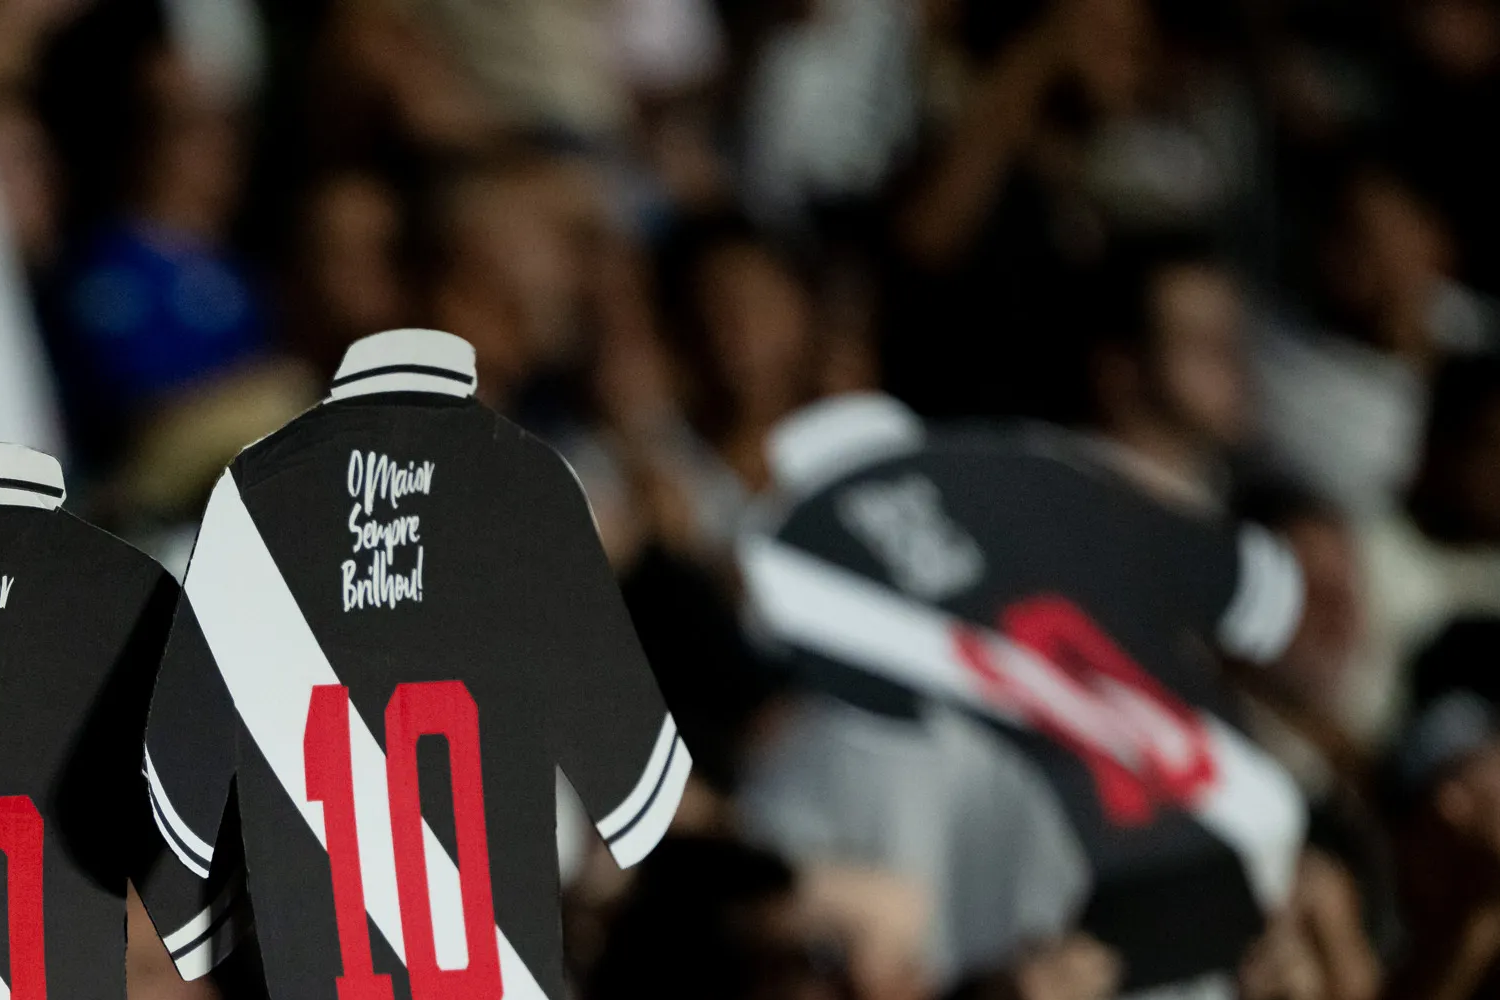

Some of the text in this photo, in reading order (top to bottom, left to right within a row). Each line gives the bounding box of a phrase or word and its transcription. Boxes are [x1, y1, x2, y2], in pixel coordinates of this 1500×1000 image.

[347, 449, 435, 516] O Maior
[348, 502, 421, 566] Sempre
[340, 545, 424, 612] Brilhou!
